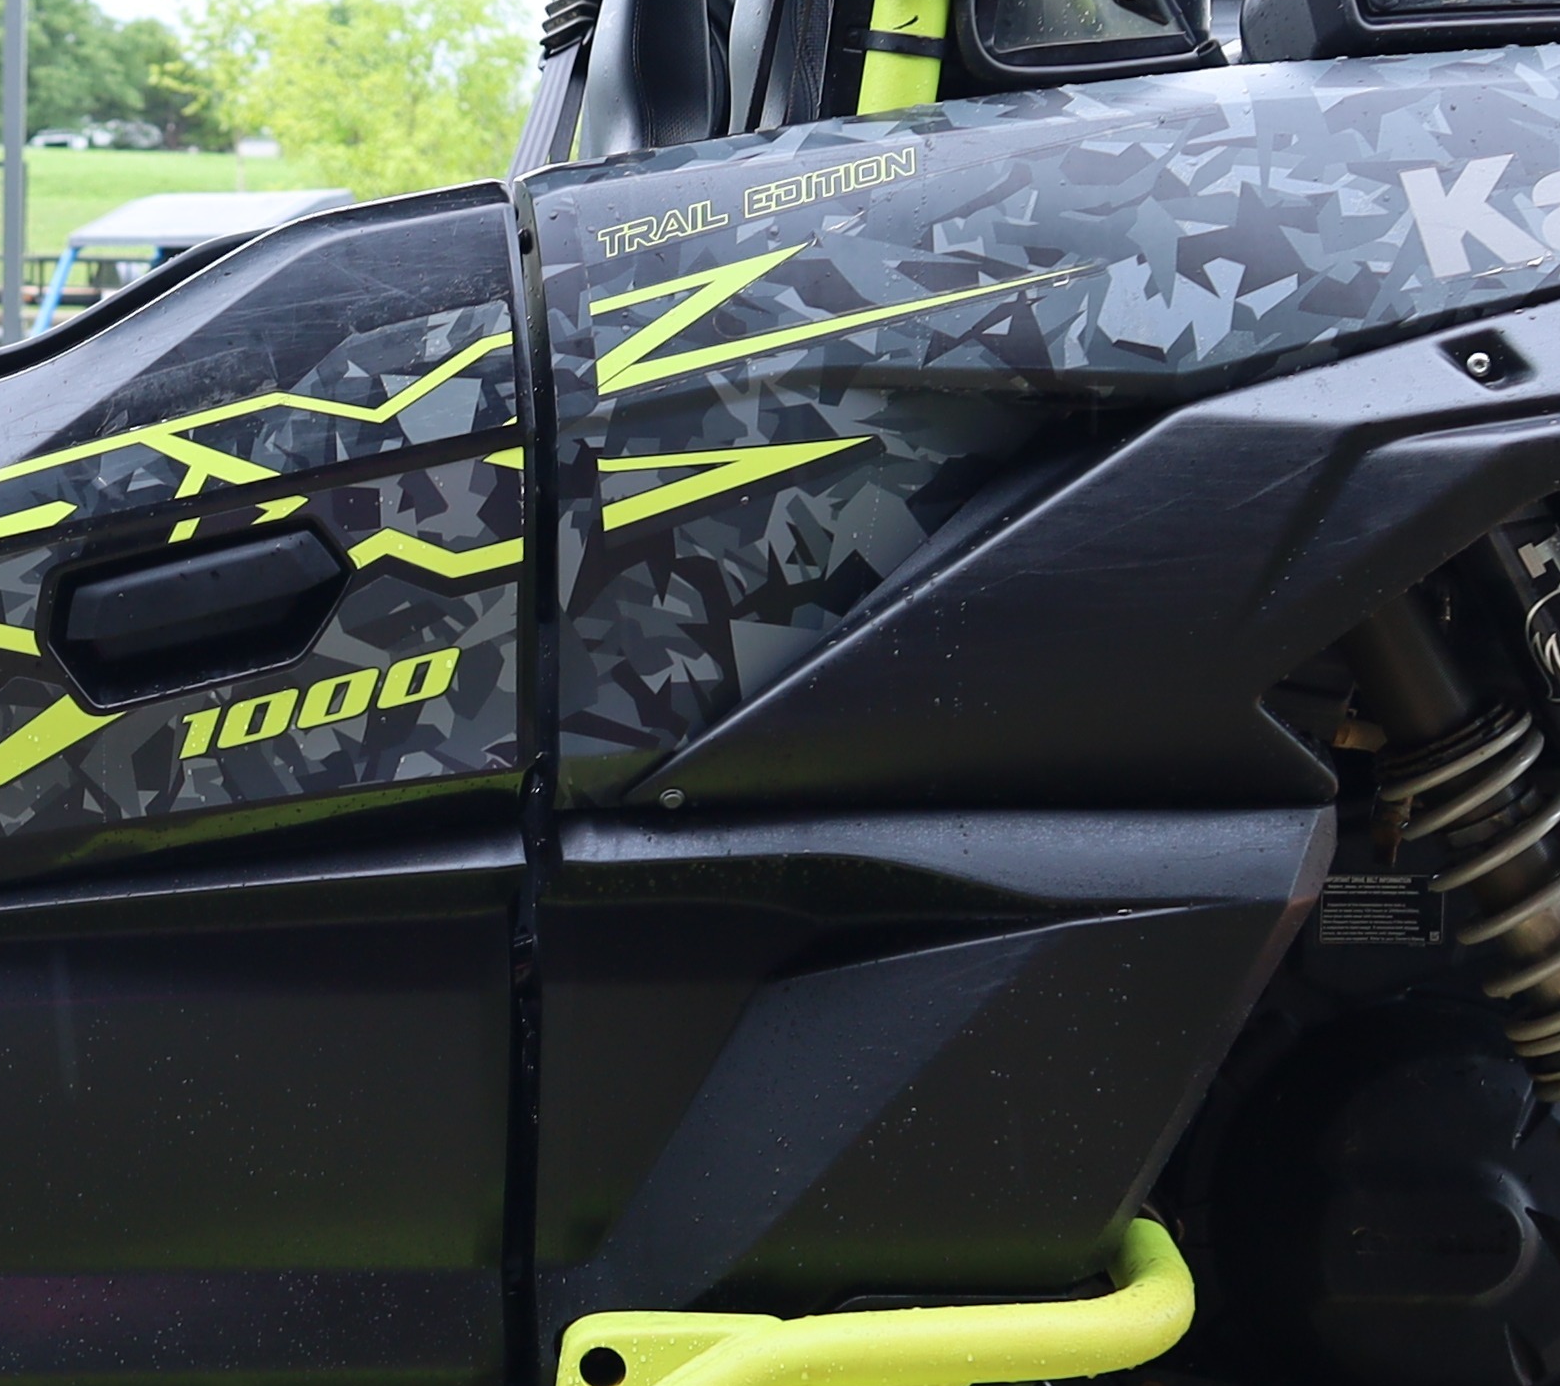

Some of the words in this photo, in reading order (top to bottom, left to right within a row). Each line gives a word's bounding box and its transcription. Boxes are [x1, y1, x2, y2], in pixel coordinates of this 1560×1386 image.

[597, 200, 730, 259] TRAIL
[744, 146, 917, 219] EDITION
[179, 646, 461, 760] 1000
